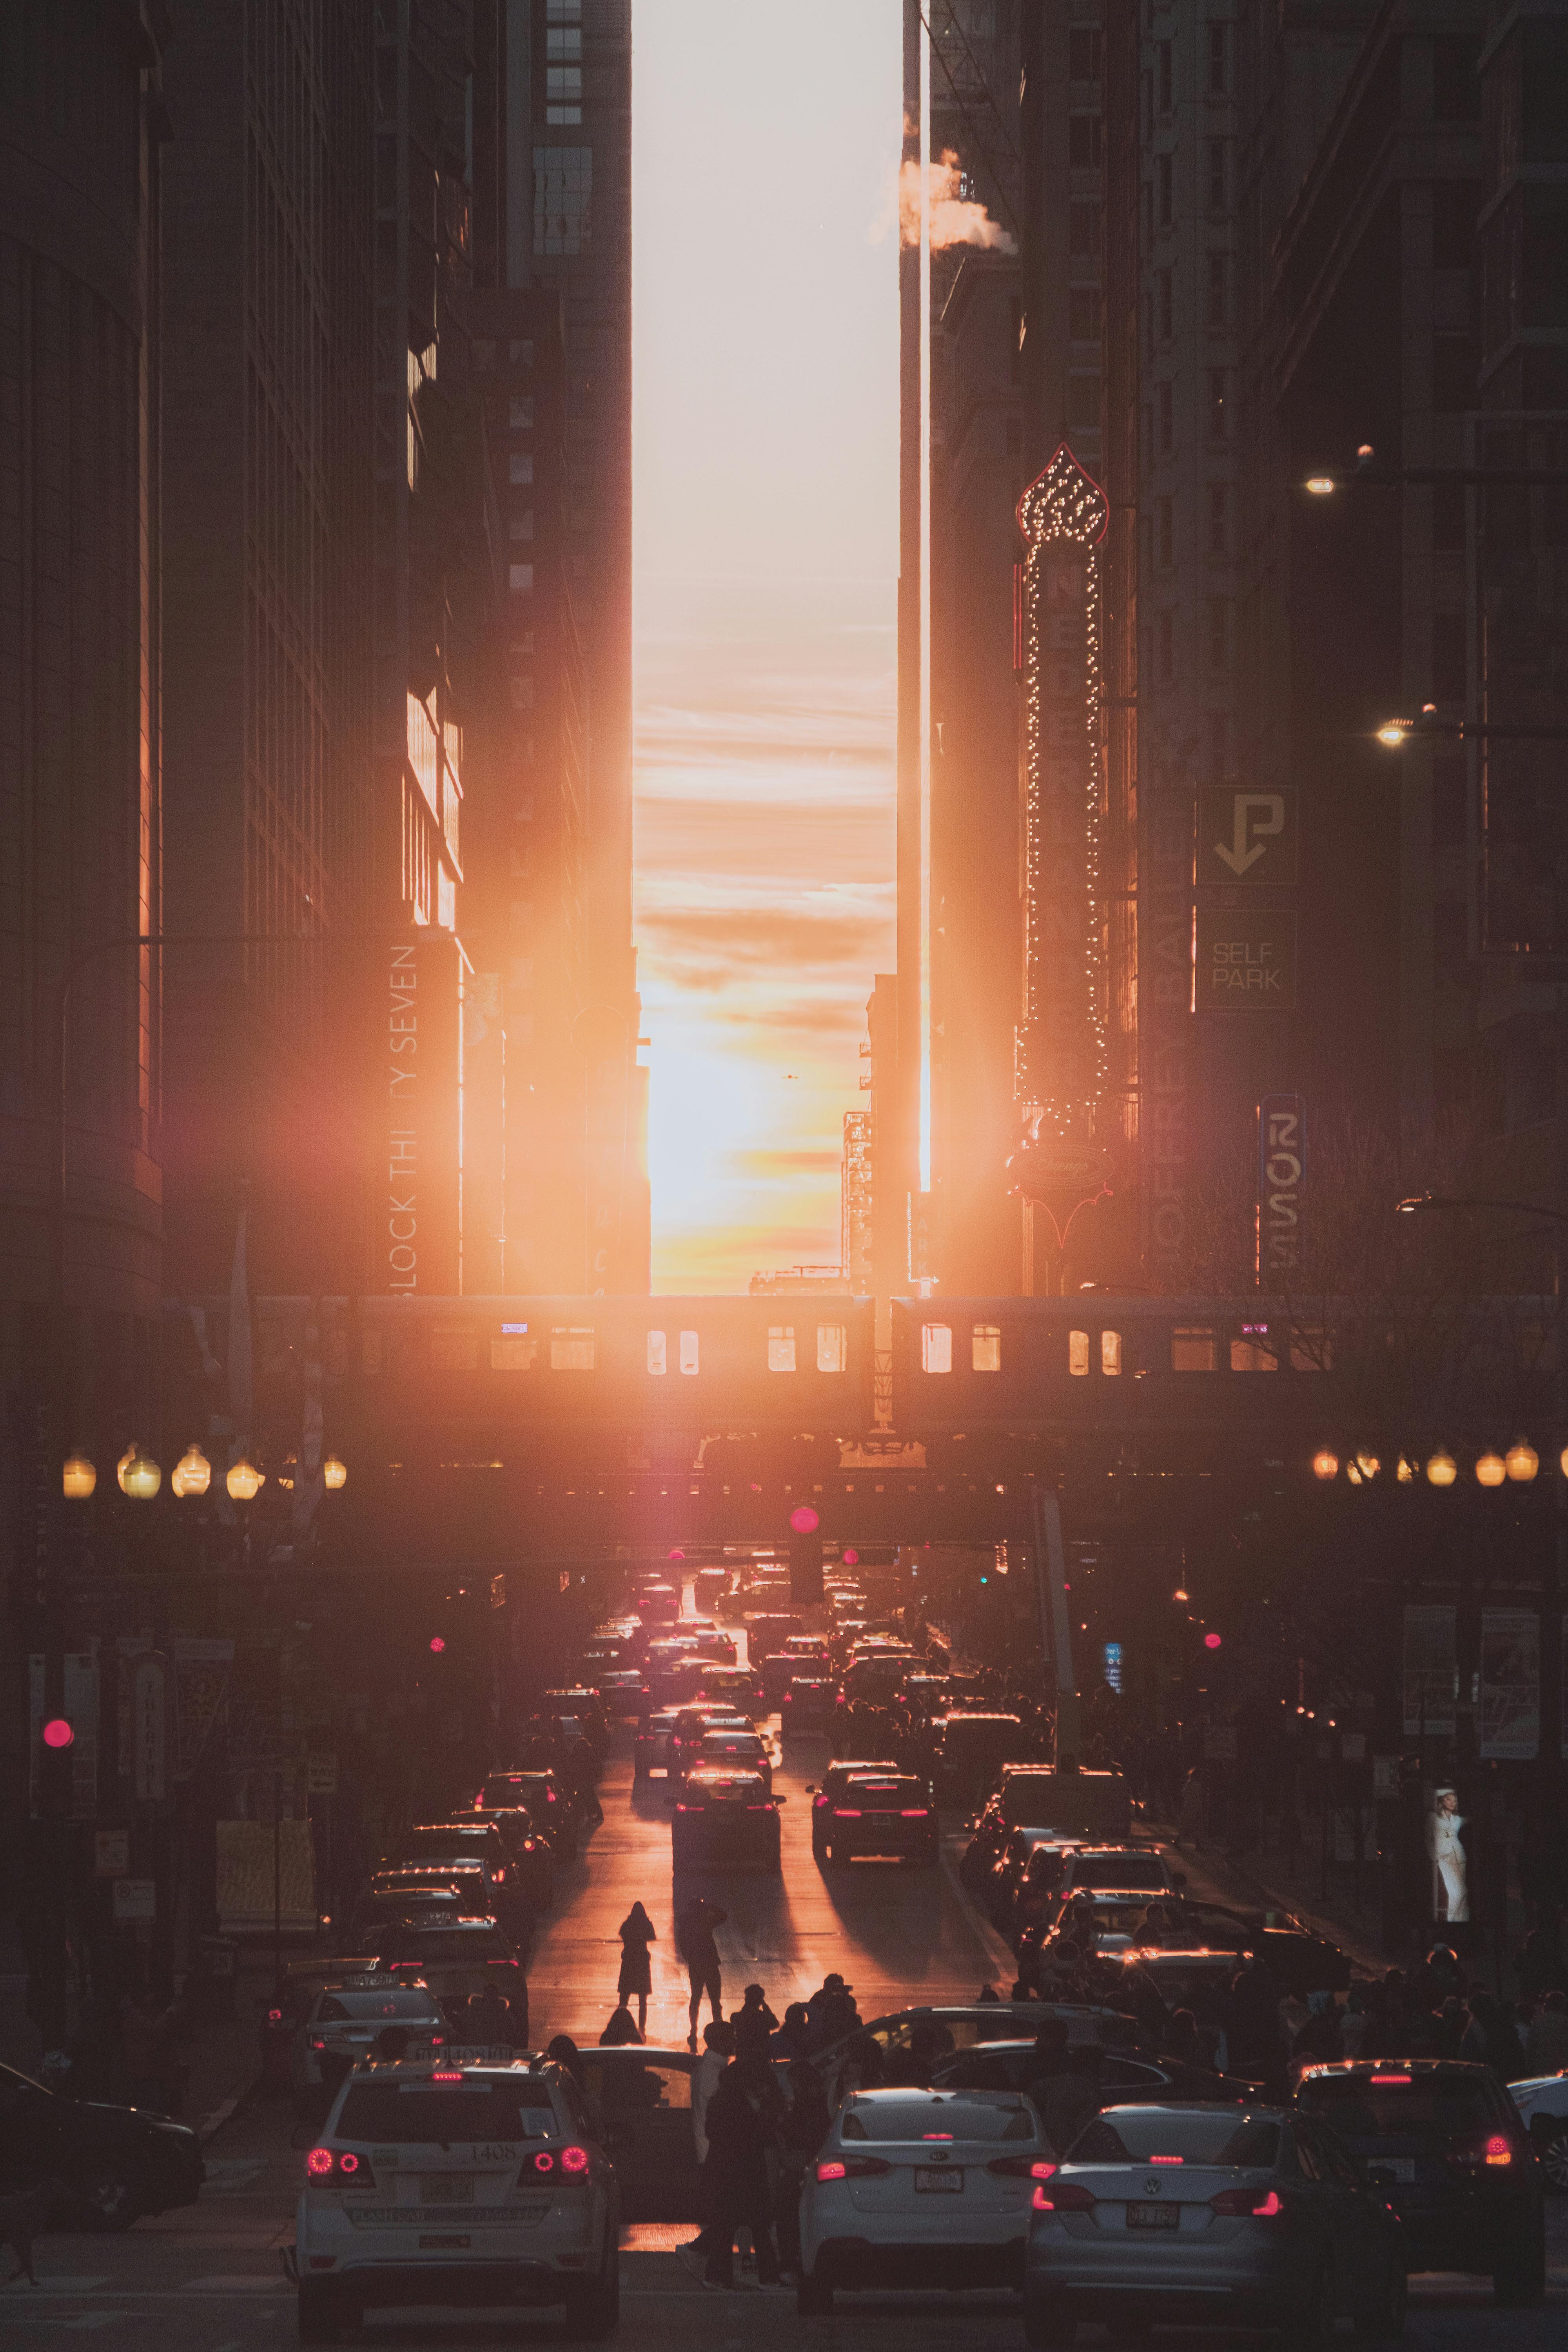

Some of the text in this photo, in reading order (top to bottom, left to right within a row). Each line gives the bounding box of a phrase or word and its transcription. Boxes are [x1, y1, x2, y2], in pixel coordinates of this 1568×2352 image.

[1046, 564, 1082, 1087] NEDERLANDER
[390, 946, 416, 1053] SEVEN
[1213, 943, 1272, 964] SELF
[1213, 968, 1280, 990] PARK
[1266, 1112, 1301, 1269] ROSS
[390, 1195, 416, 1296] LOCK
[471, 2144, 516, 2161] 1408
